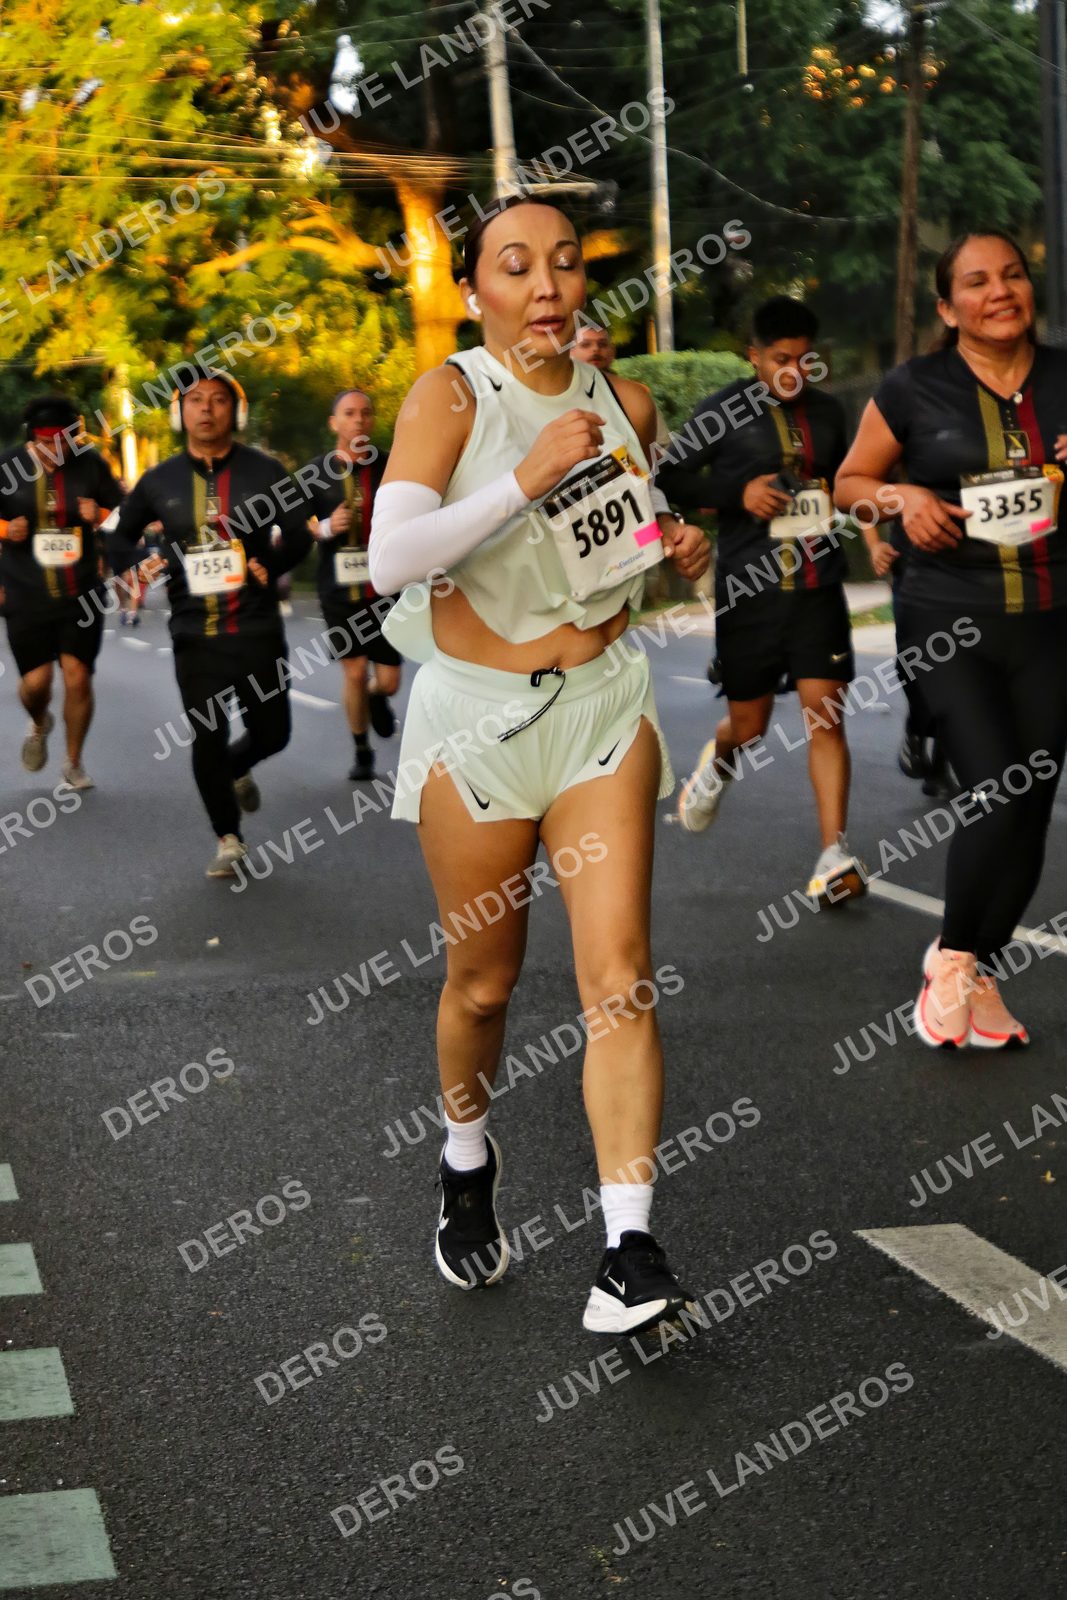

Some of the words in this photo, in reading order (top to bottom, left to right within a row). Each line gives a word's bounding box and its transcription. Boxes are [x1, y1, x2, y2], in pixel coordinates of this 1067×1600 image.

[778, 497, 820, 517] 201
[977, 489, 1043, 523] 3355
[571, 488, 645, 559] 5891
[192, 556, 233, 576] 7554
